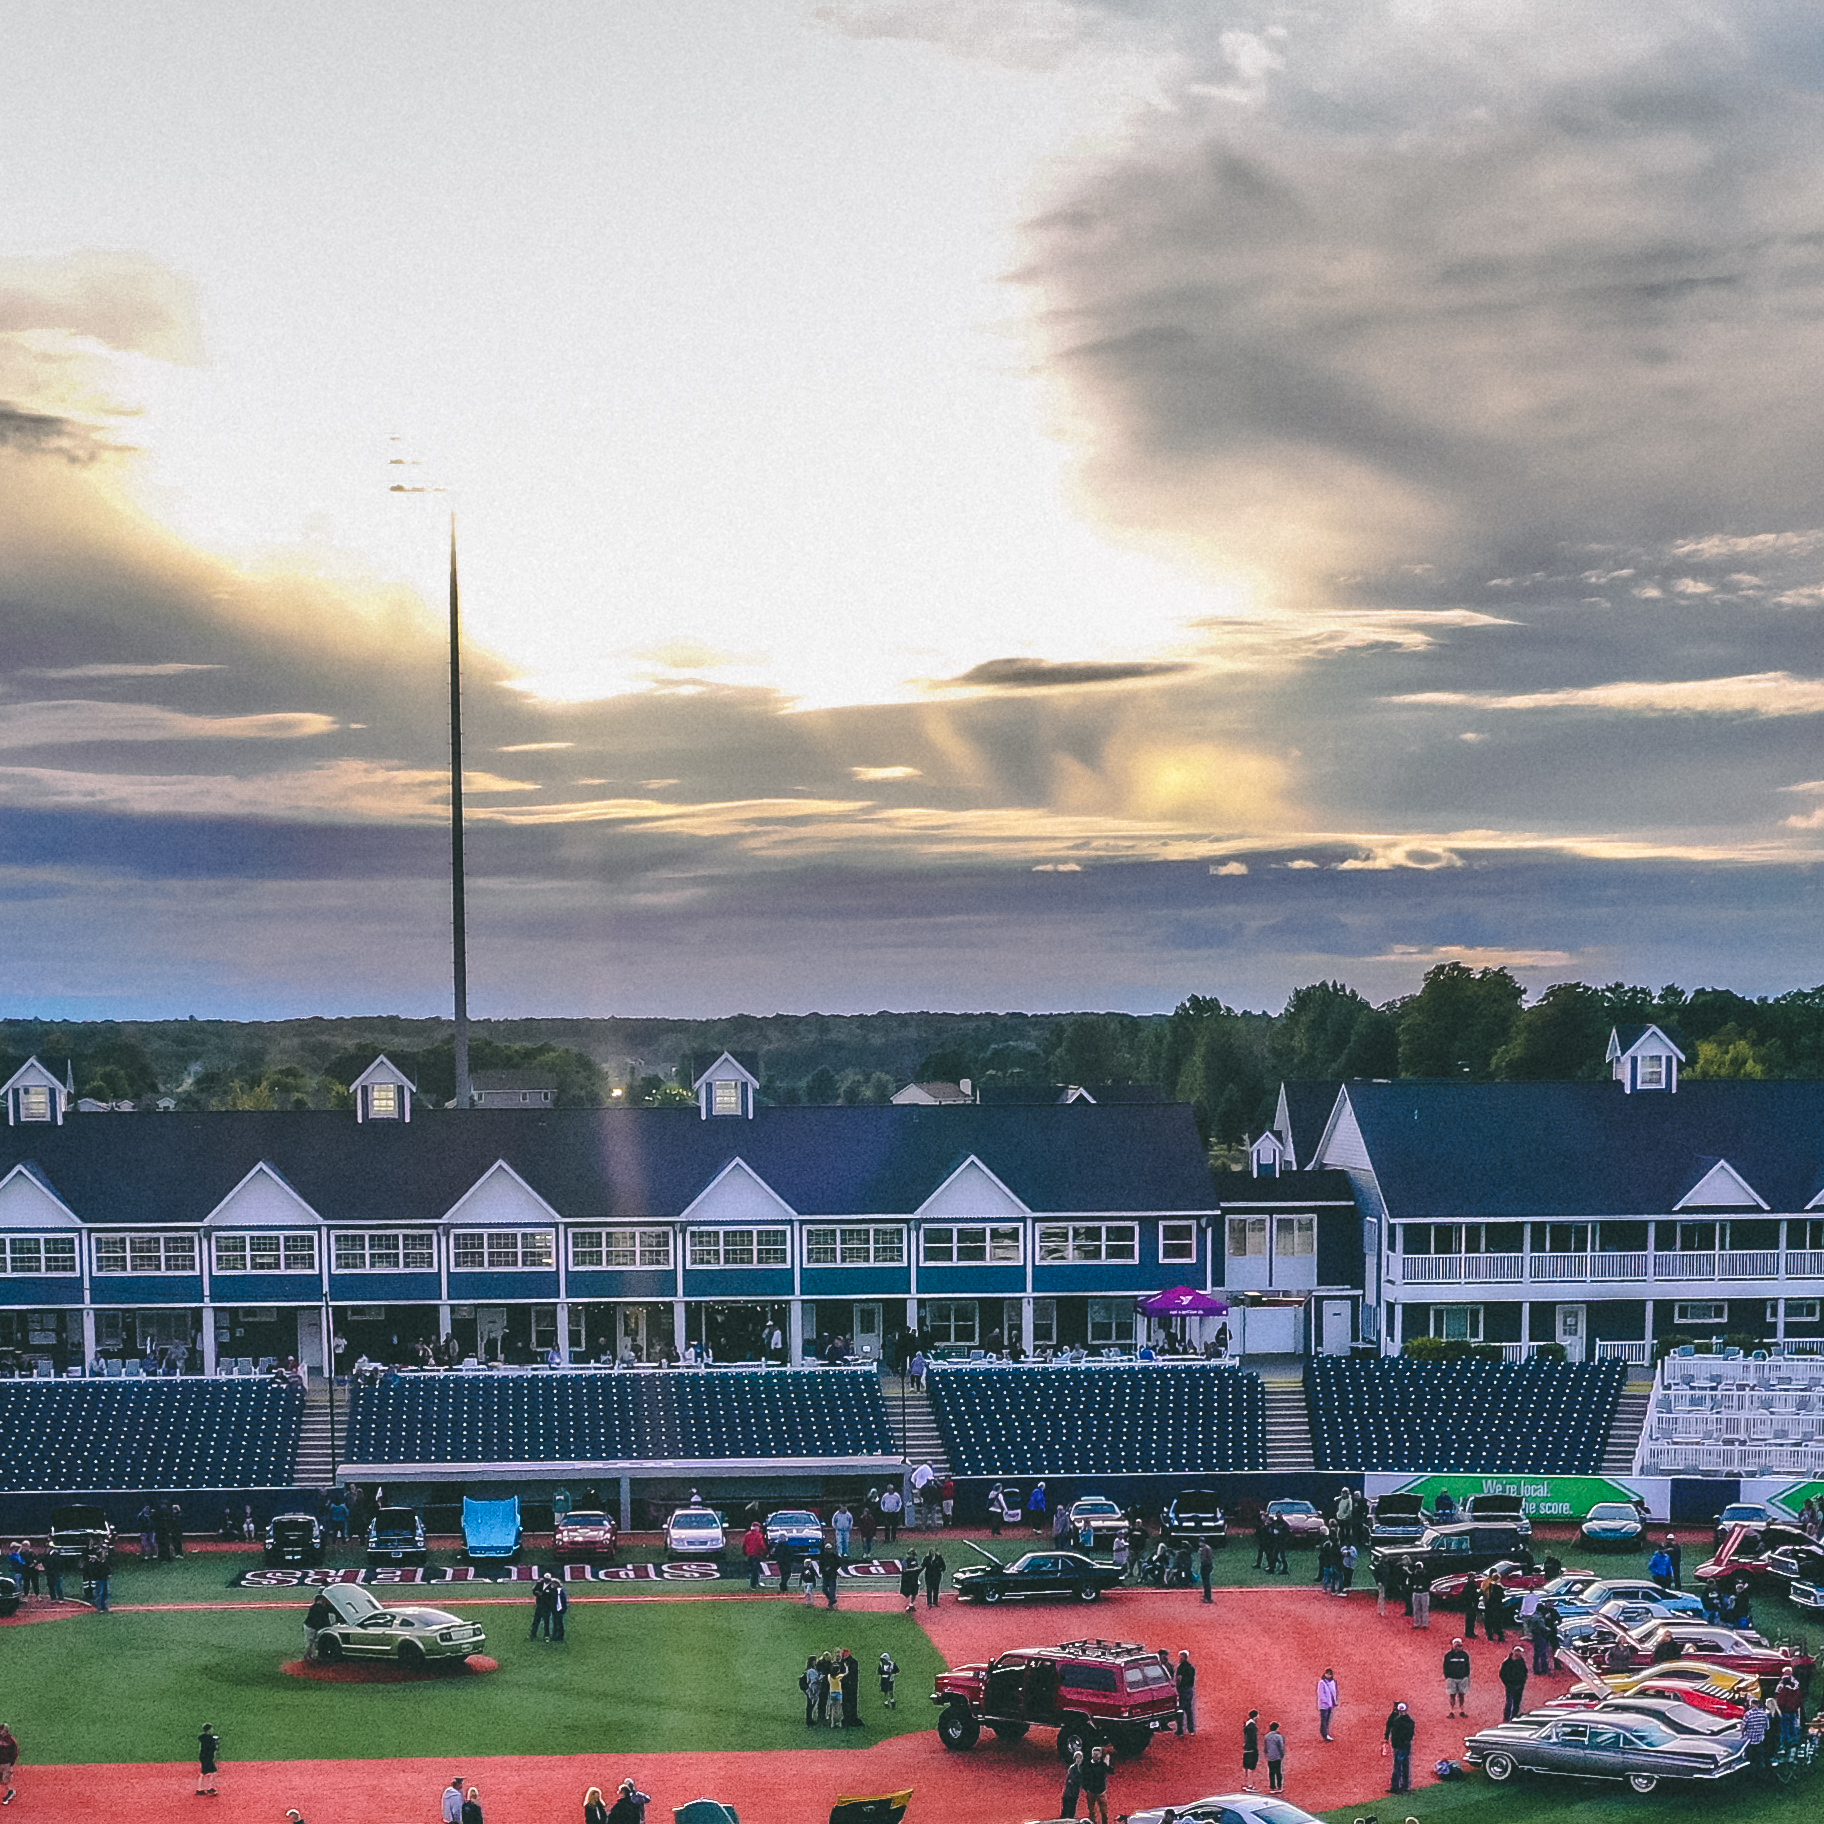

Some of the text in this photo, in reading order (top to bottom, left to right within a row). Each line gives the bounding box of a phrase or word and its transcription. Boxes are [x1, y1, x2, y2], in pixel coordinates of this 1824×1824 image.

[1482, 1480, 1551, 1497] We're local.
[1522, 1500, 1574, 1515] he score.
